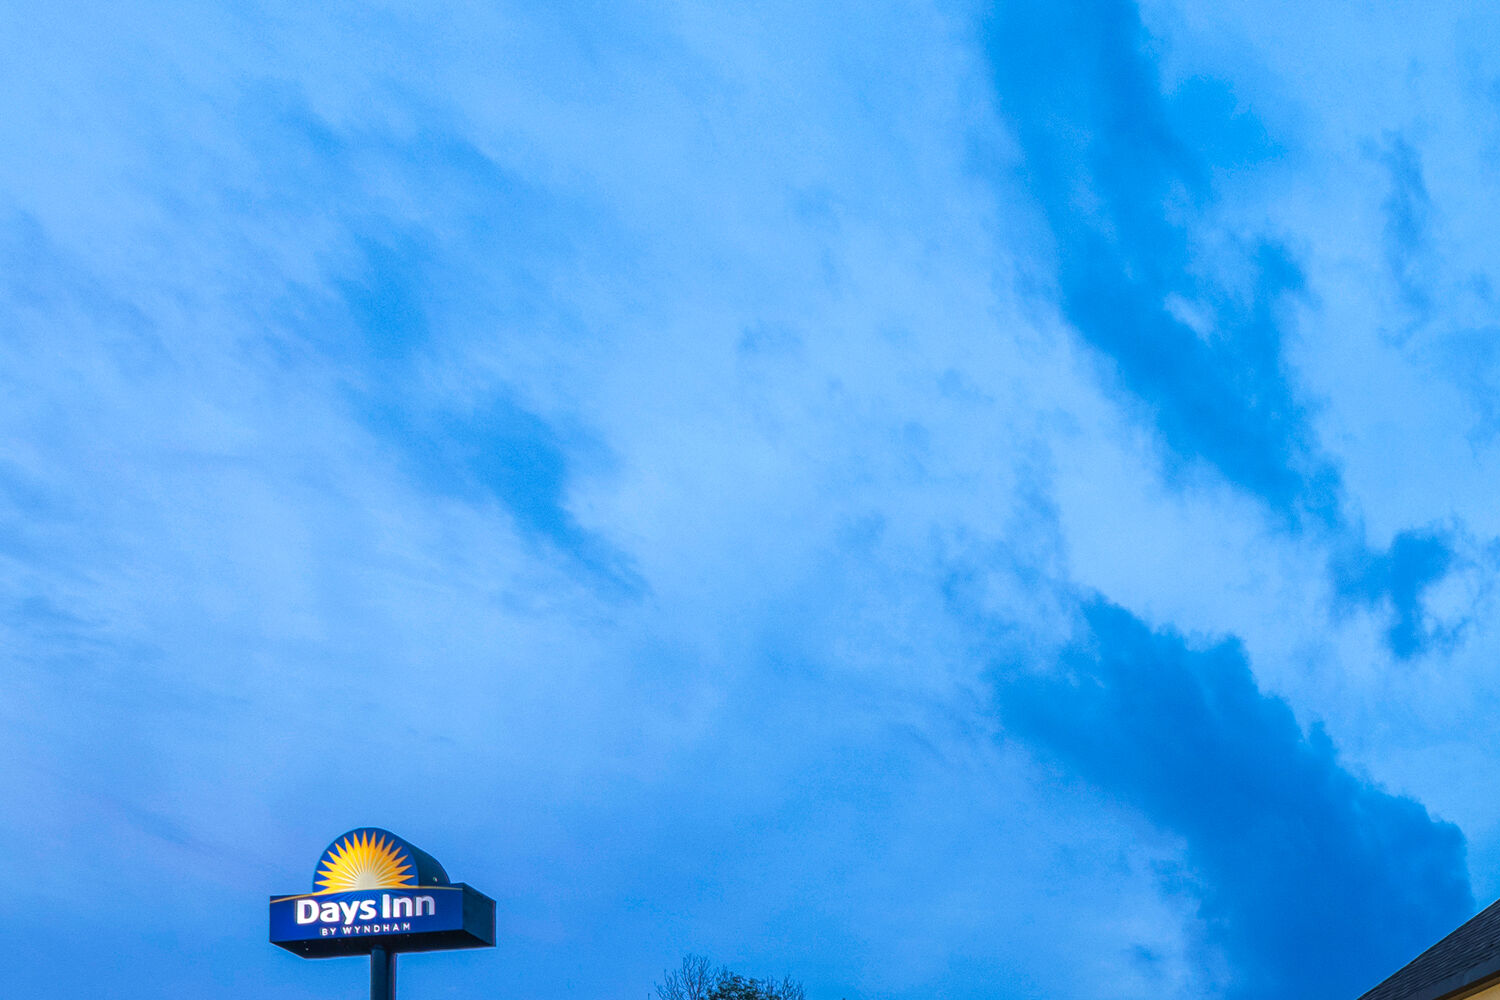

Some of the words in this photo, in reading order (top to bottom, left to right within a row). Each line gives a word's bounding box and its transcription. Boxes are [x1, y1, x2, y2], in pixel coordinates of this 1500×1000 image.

[296, 899, 377, 925] Days
[382, 894, 435, 918] Inn
[321, 927, 336, 936] BY
[342, 923, 411, 935] WYNDHAM
